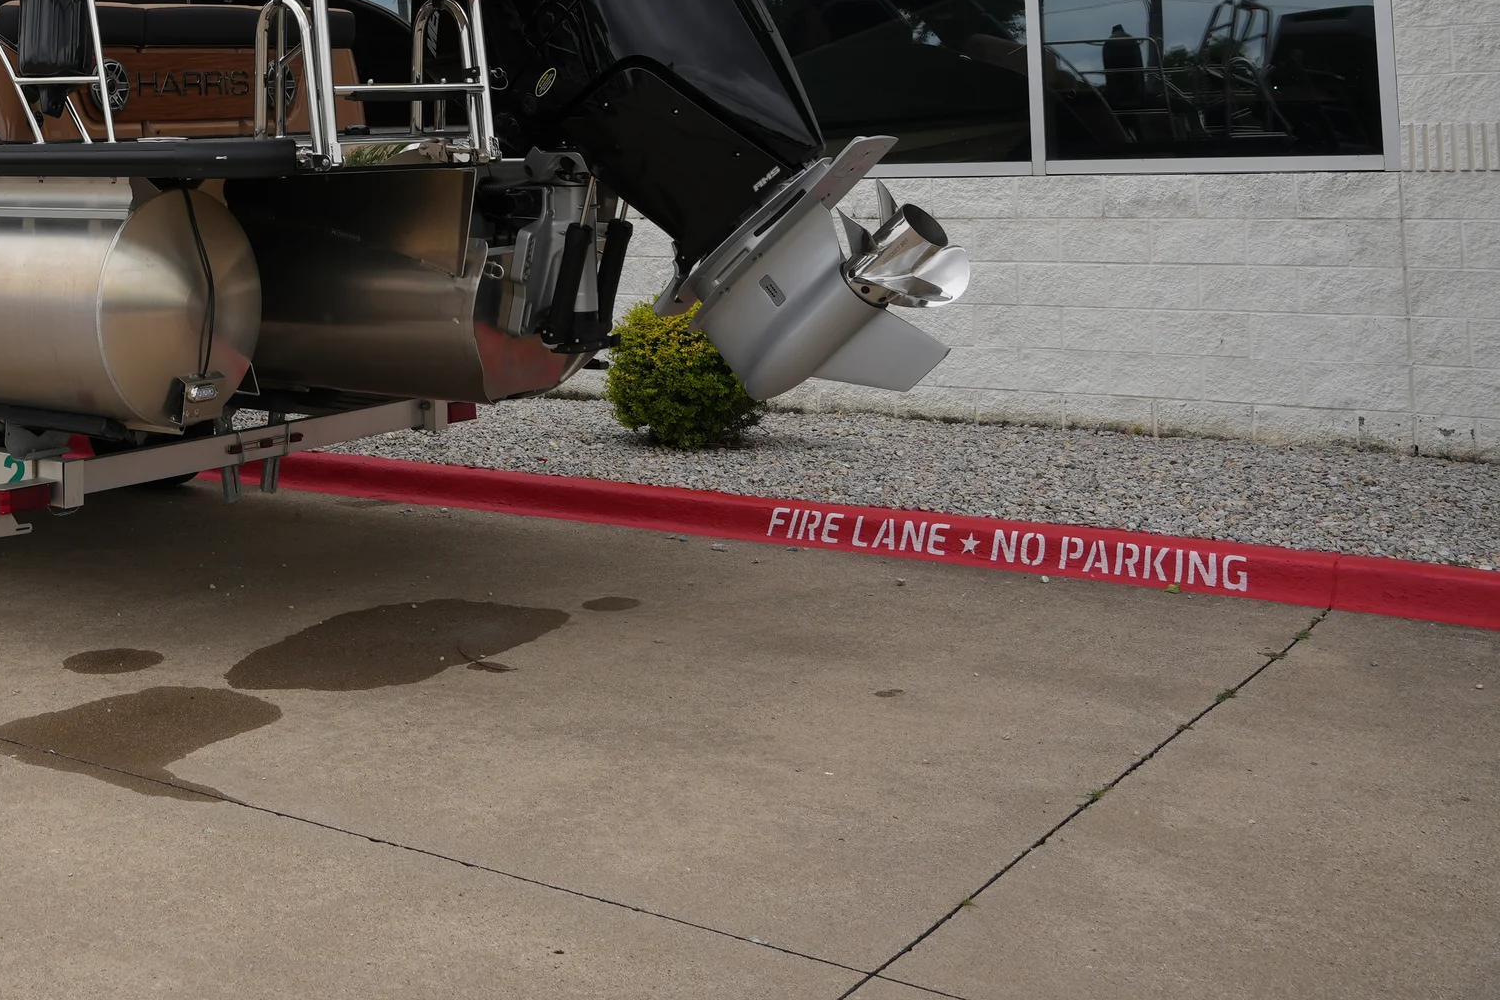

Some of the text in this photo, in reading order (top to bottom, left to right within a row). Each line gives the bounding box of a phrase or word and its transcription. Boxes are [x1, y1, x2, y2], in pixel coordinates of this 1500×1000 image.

[135, 70, 250, 97] HARRIS
[766, 506, 1248, 592] FIRE LANE NO PARKING
